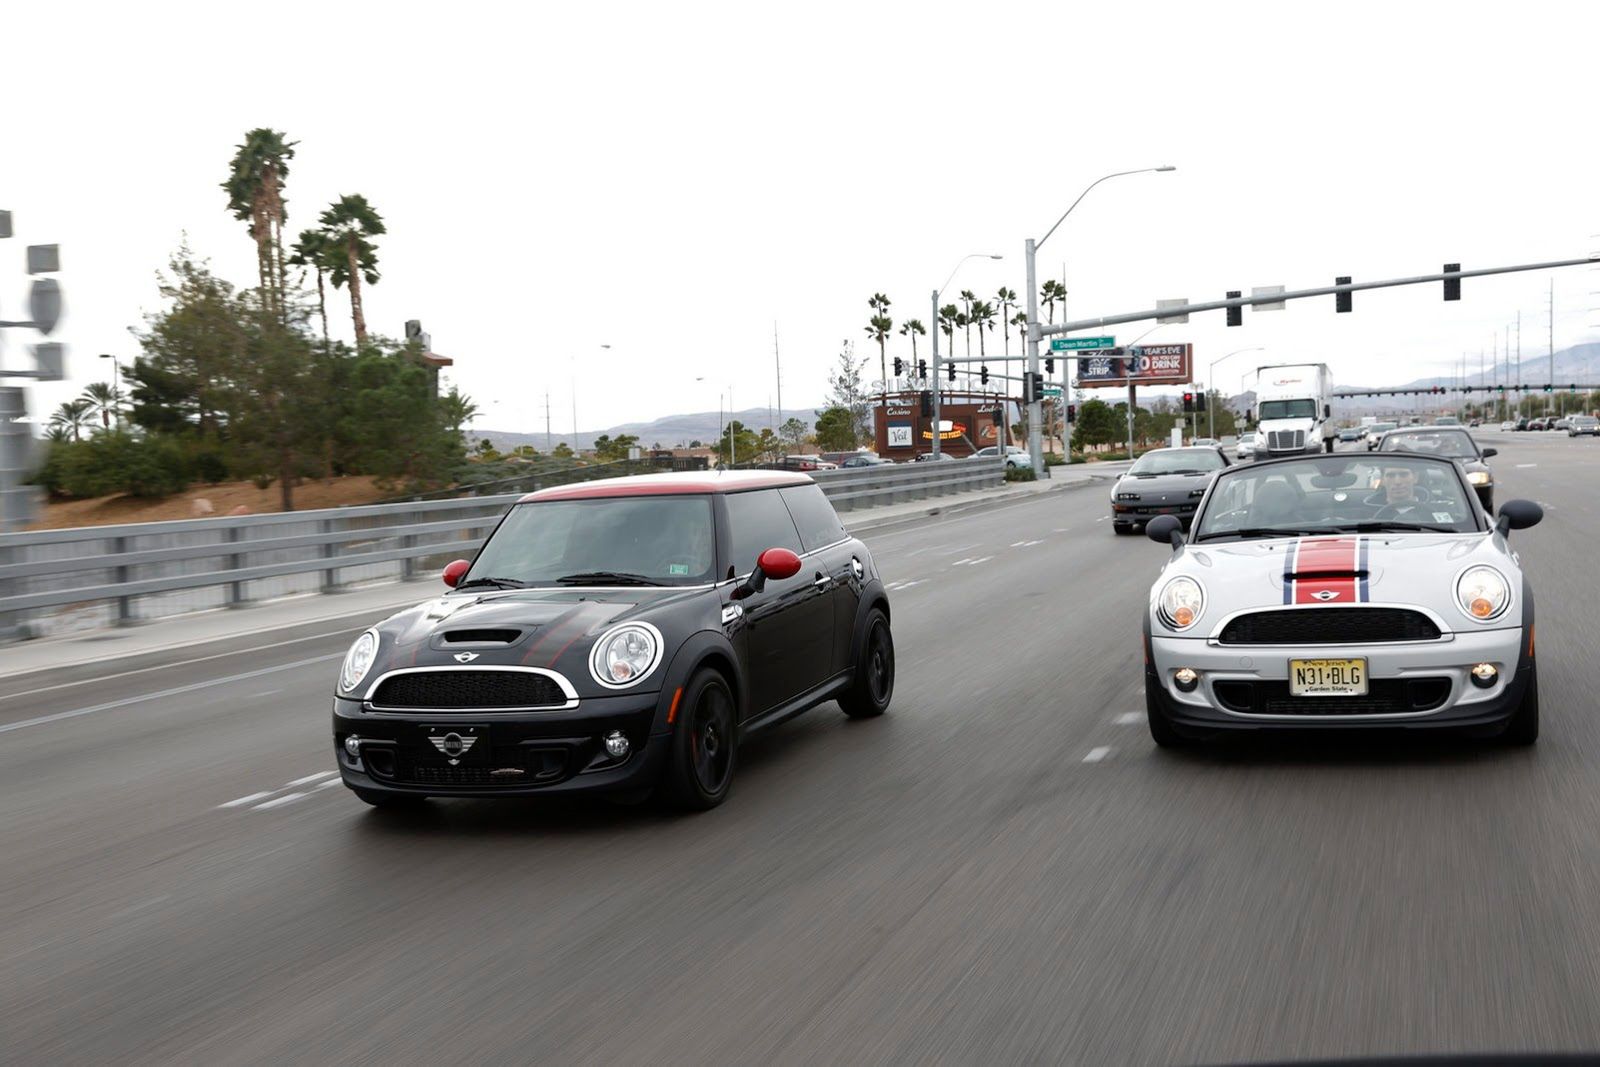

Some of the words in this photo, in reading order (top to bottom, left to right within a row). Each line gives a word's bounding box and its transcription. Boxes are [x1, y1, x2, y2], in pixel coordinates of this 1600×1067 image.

[1144, 347, 1167, 355] YEAR'S
[1168, 346, 1180, 354] EVE
[1152, 360, 1180, 369] DRINK
[1088, 367, 1109, 376] STRIP
[886, 407, 911, 416] Casino
